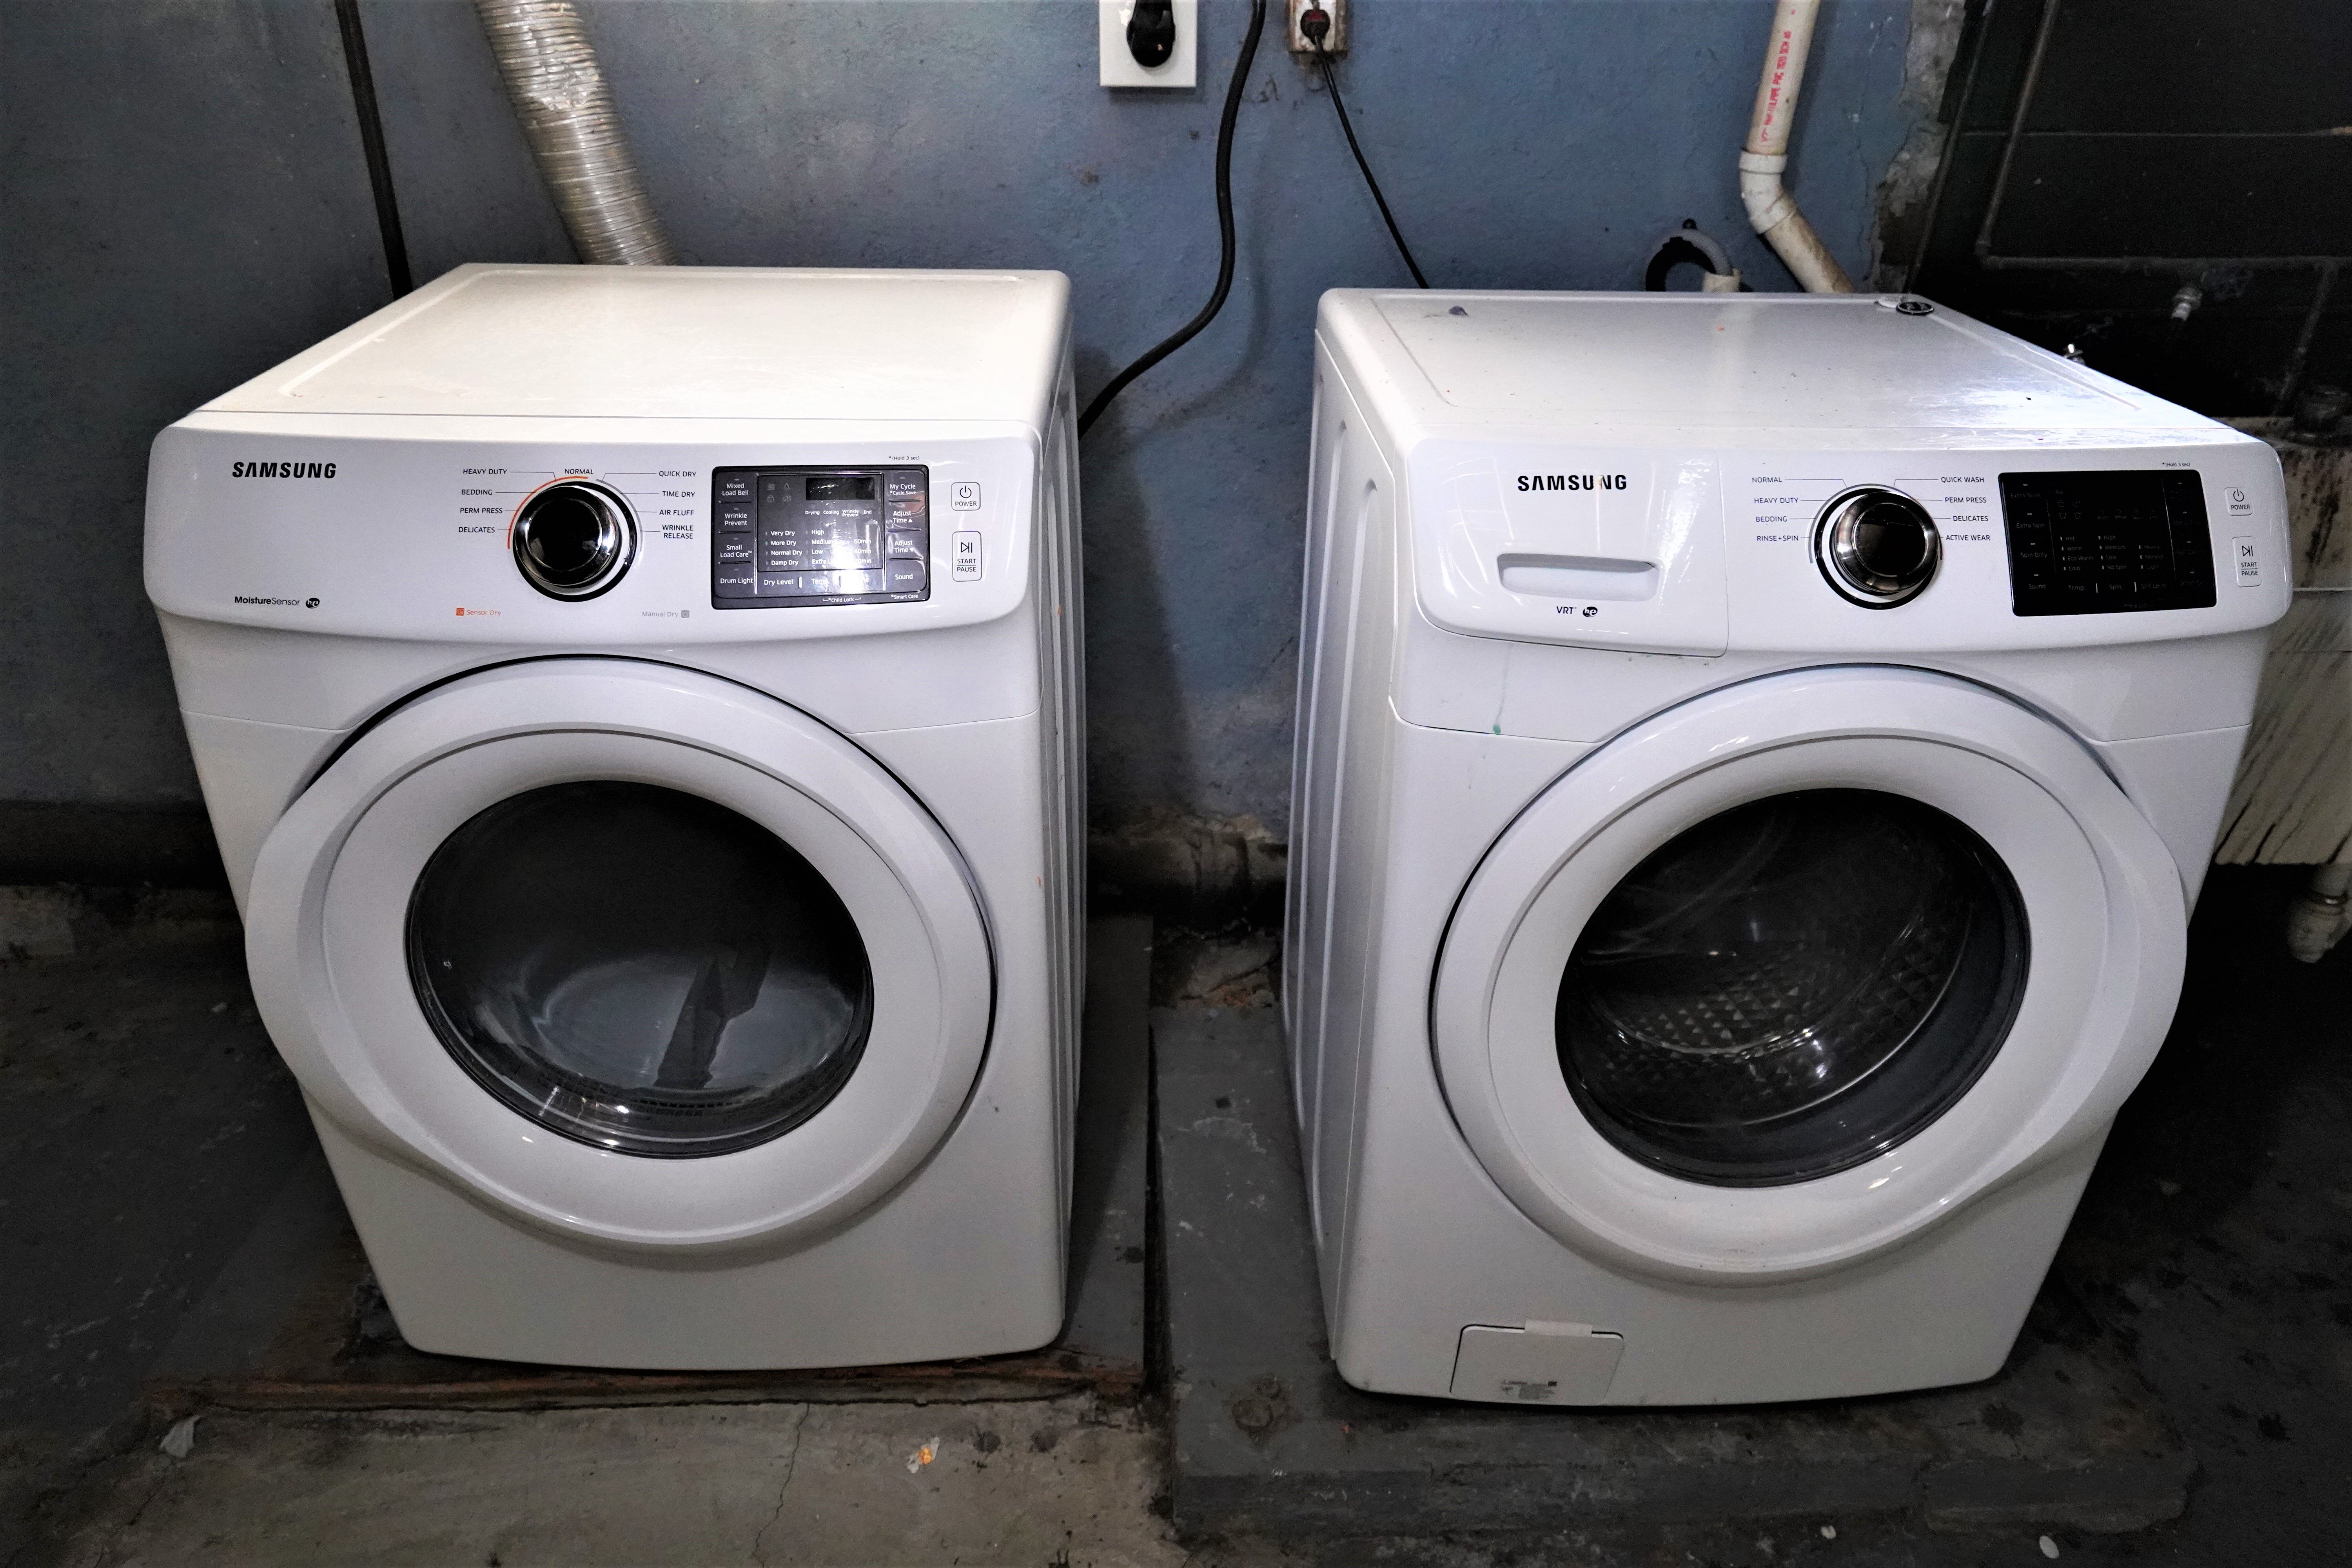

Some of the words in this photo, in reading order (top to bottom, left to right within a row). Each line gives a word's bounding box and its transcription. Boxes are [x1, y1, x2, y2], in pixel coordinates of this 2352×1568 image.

[232, 462, 336, 478] SAMSUNG
[1517, 474, 1627, 491] SAMSUNG
[234, 596, 299, 606] MoistureSensor
